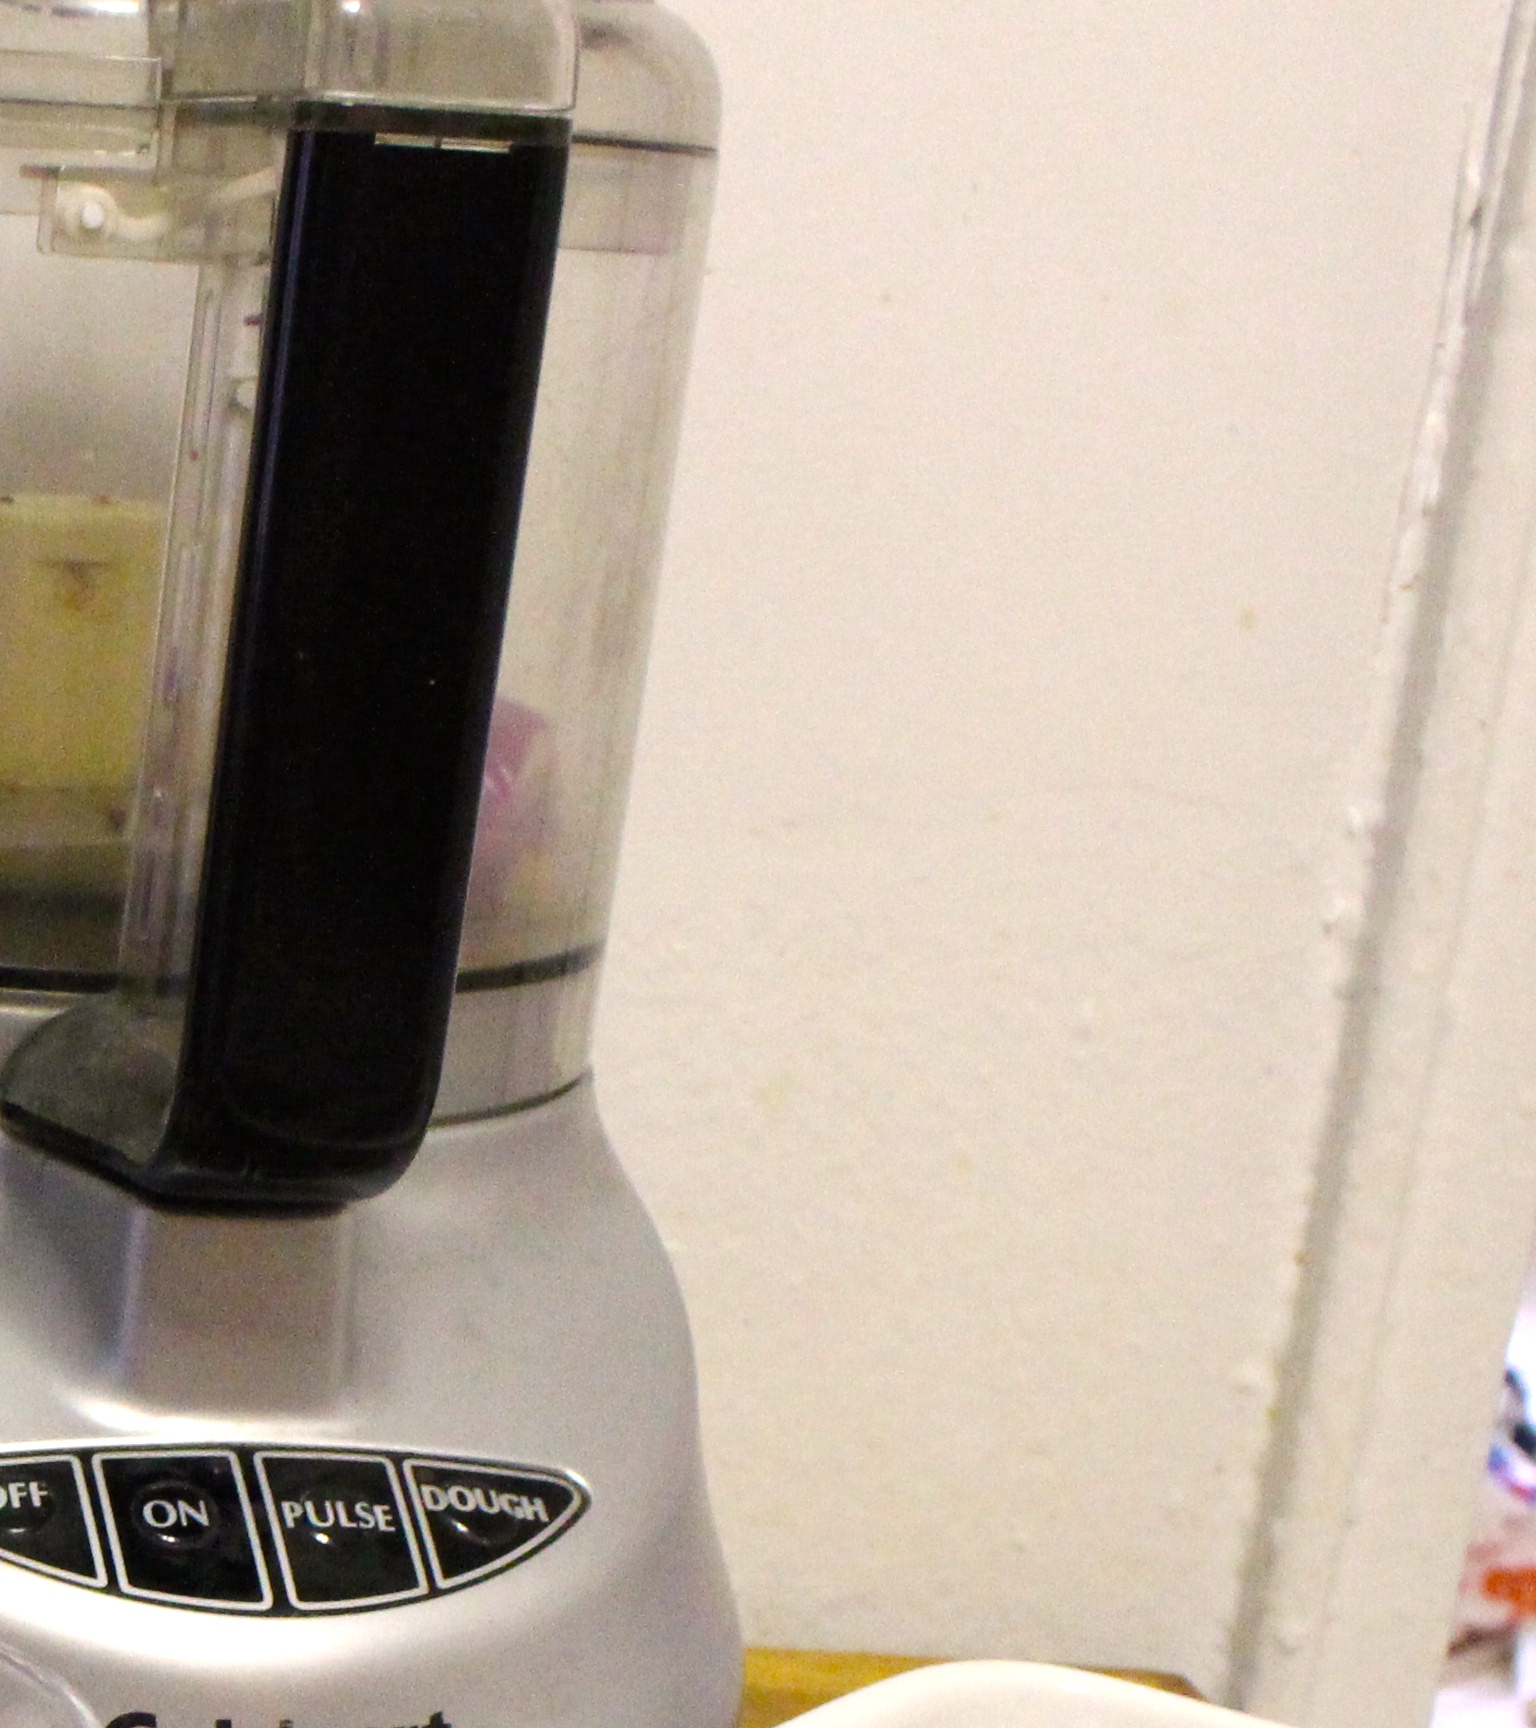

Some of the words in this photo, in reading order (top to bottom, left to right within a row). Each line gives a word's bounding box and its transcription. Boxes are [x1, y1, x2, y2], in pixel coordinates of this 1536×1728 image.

[142, 1500, 210, 1529] ON
[283, 1500, 397, 1533] PULSE
[422, 1483, 550, 1525] DOUGH
